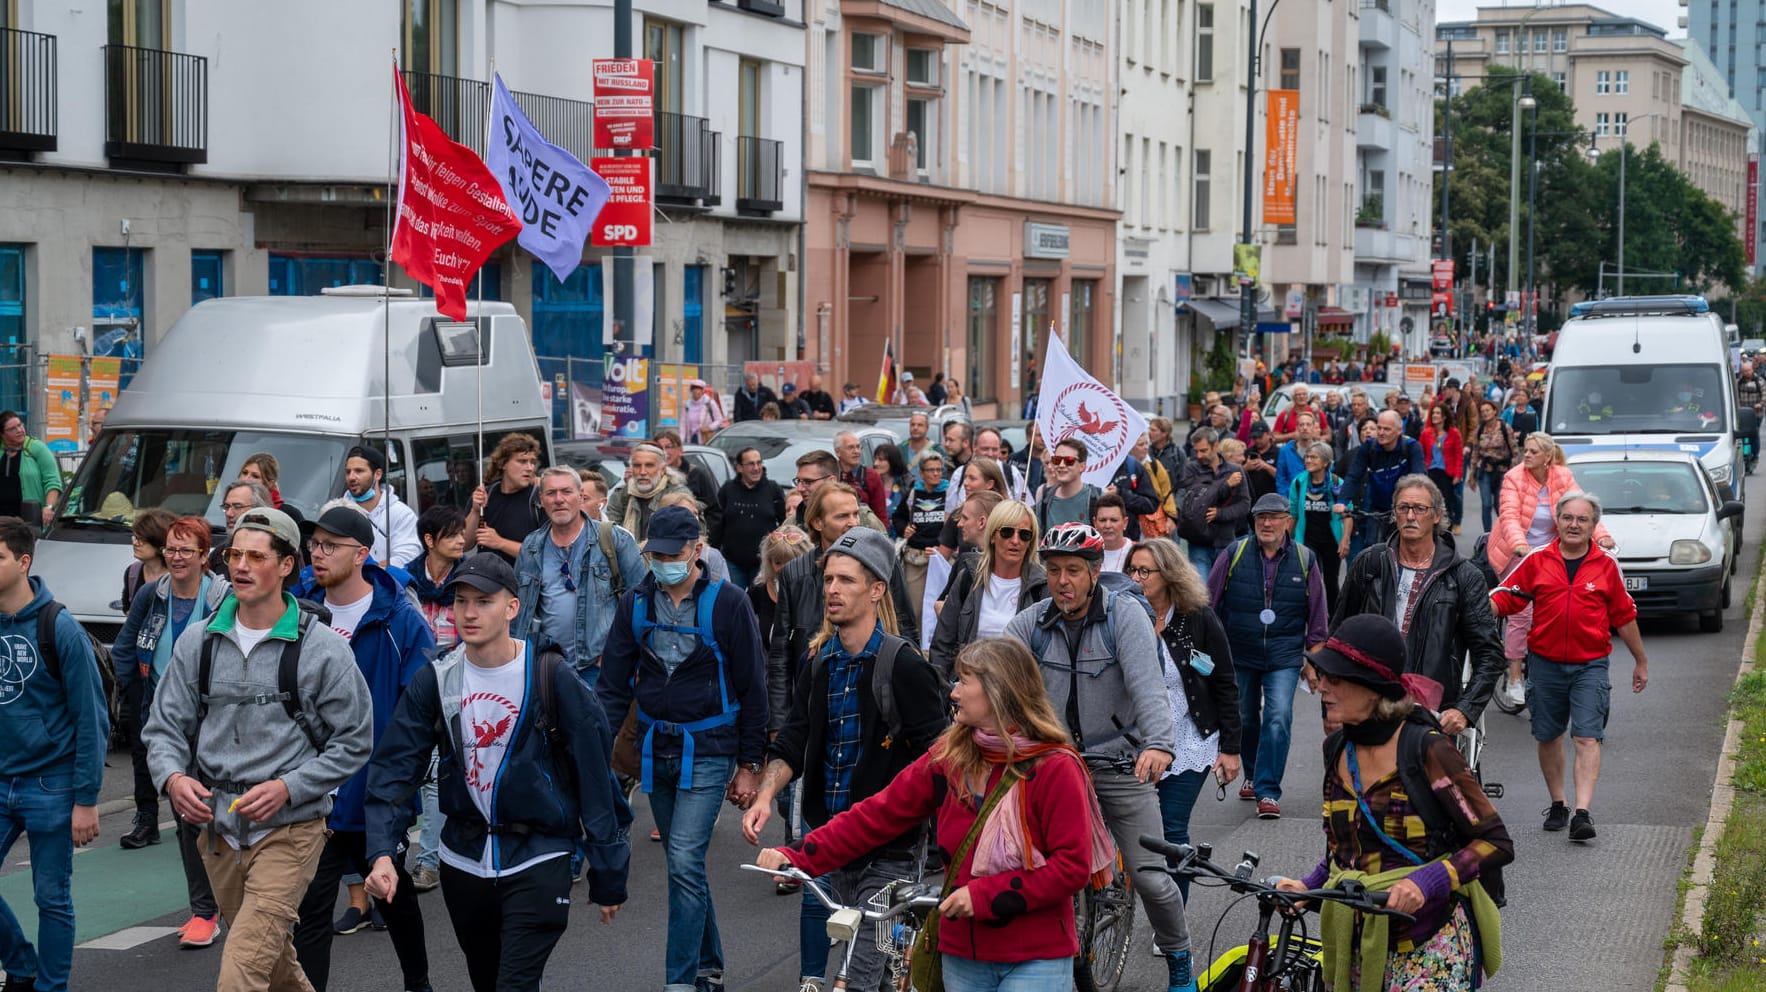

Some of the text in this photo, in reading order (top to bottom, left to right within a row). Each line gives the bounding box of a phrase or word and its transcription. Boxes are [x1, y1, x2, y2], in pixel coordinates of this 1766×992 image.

[596, 64, 635, 73] FRIEDEN
[611, 80, 646, 88] RUSSLAND
[1276, 120, 1286, 180] Demokratie
[503, 115, 589, 217] SAPERE
[606, 176, 634, 184] STABILE
[434, 162, 468, 190] feigen
[466, 182, 513, 220] Gestalten.
[610, 186, 644, 194] TEN UND
[508, 166, 561, 240] AUDE
[415, 215, 430, 234] das
[604, 225, 638, 240] SPD
[434, 248, 457, 268] Euch
[604, 352, 644, 382] Volt
